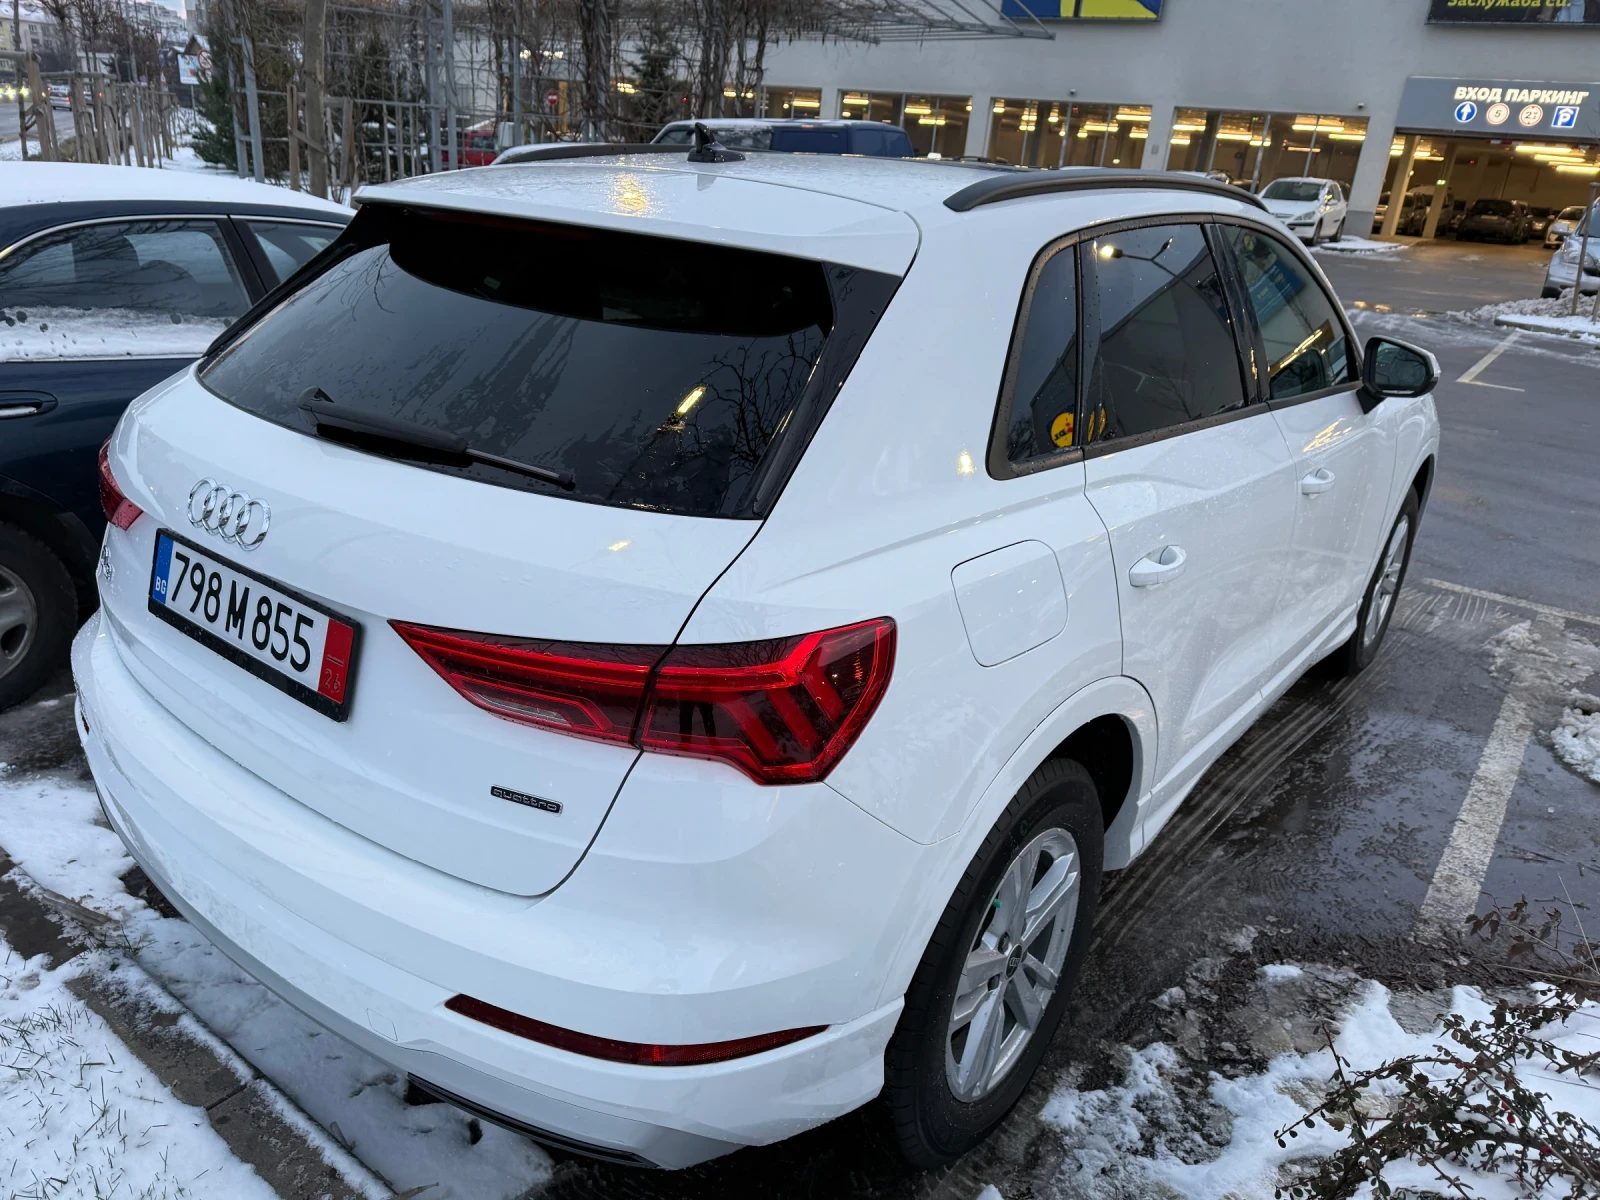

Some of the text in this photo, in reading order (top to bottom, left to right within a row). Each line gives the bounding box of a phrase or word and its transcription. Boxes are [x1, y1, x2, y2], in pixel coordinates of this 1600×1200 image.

[1454, 86, 1589, 105] ВХОД ПАРКИНГ
[155, 575, 168, 595] BG
[171, 551, 222, 623] 798
[225, 580, 250, 640] M
[251, 596, 314, 673] 855
[323, 668, 341, 692] 26
[493, 788, 557, 811] quattro
